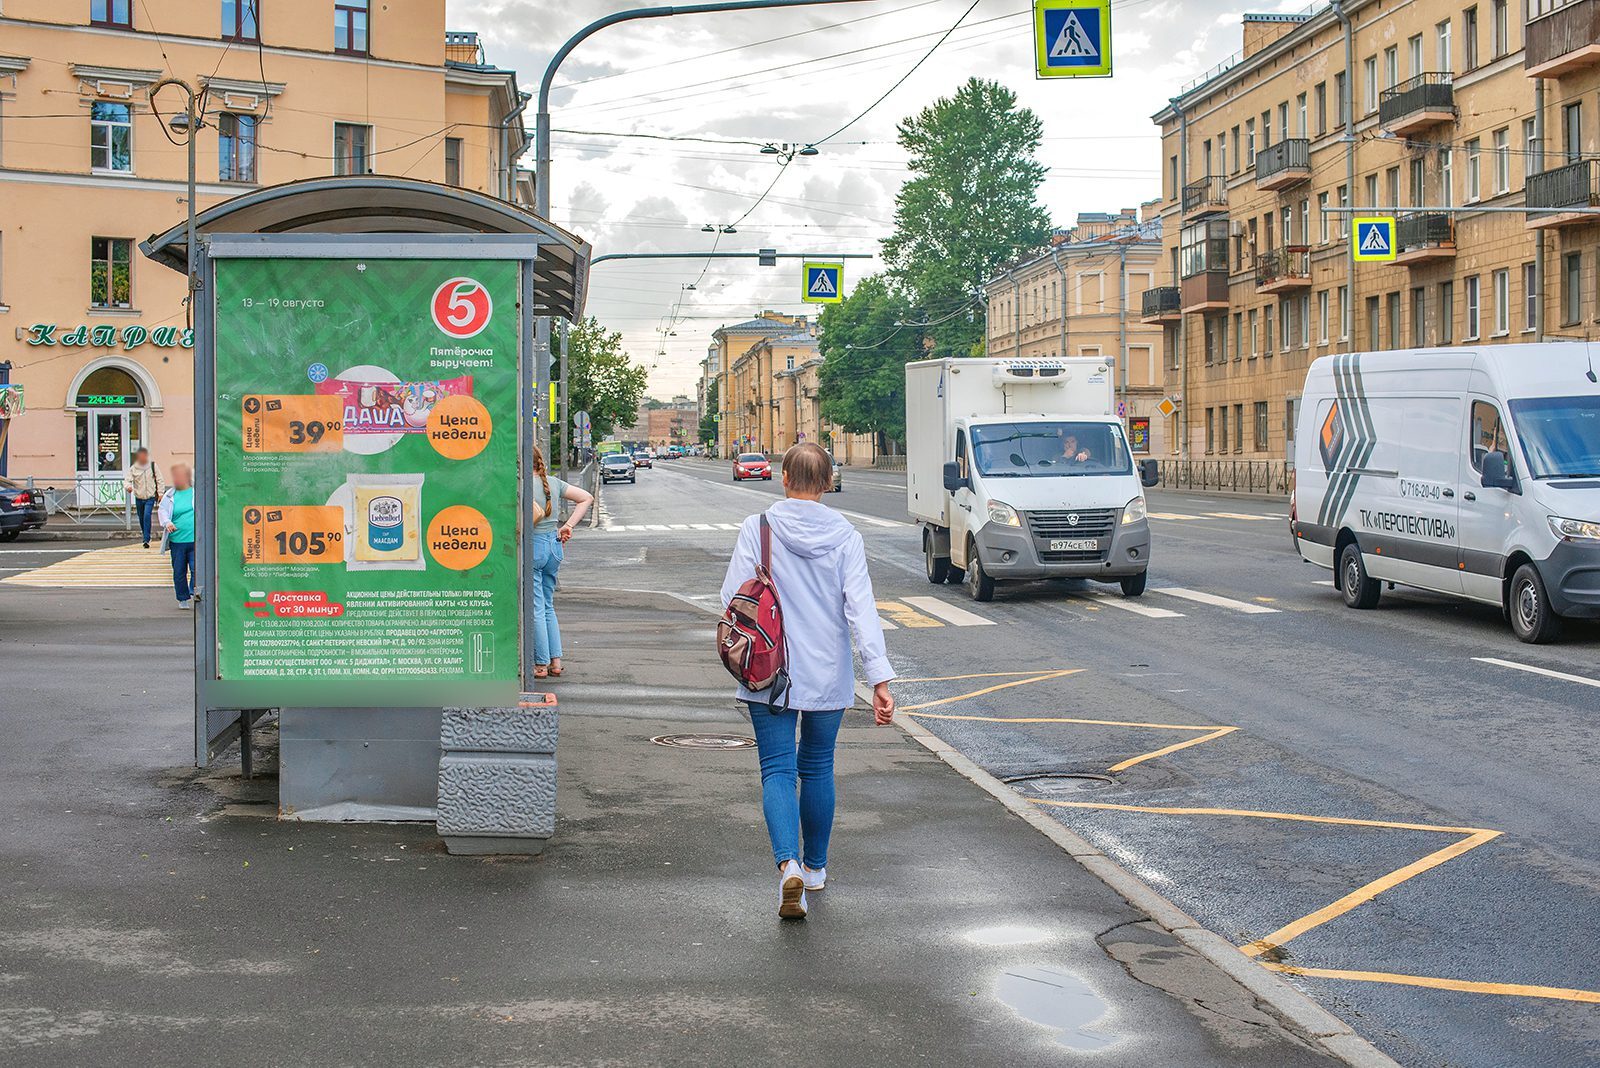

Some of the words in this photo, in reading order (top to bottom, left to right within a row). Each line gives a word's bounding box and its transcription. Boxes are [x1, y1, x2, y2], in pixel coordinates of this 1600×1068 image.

[242, 298, 253, 308] 13
[268, 298, 279, 308] 19
[282, 299, 325, 310] августа
[430, 347, 493, 358] Пятёрочка
[430, 360, 493, 370] выручает!
[343, 406, 405, 427] ДАША
[440, 415, 479, 427] Цена
[289, 421, 325, 445] 39
[432, 429, 486, 440] недели
[1407, 482, 1440, 500] 716-20-40
[1360, 509, 1373, 528] ТК
[1374, 512, 1455, 539] «ПЕРСПЕКТИВА»
[440, 526, 479, 537] Цена
[275, 531, 326, 555] 105
[432, 539, 487, 550] недели
[273, 593, 321, 603] Доставка
[346, 591, 379, 599] АКЦИОННЫЕ
[380, 591, 396, 599] ЦЕНЫ
[396, 591, 441, 599] ДЕЙСТВИТЕЛЬНЫ
[441, 591, 462, 599] ТОЛЬКО
[463, 591, 473, 599] ПРИ
[280, 606, 292, 614] от
[293, 606, 305, 614] 30
[307, 606, 339, 616] минут
[332, 620, 364, 628] КОЛИЧЕСТВО
[365, 620, 385, 628] ТОВАРА
[244, 629, 276, 637] МАГАЗИНАХ
[276, 629, 303, 637] ТОРГОВОЙ
[319, 629, 334, 637] ЦЕНЫ
[335, 629, 359, 637] УКАЗАНЫ
[386, 629, 416, 637] ПРОДАВЕЦ
[244, 639, 259, 647] ОГРН
[356, 639, 382, 647] НЕВСКИЙ
[244, 649, 270, 657] ДОСТАВКИ
[307, 649, 345, 657] ПОДРОБНОСТИ
[355, 649, 389, 657] МОБИЛЬНОМ
[390, 649, 426, 657] ПРИЛОЖЕНИИ
[473, 634, 492, 673] 18+
[244, 659, 273, 667] ДОСТАВКУ
[274, 659, 319, 667] ОСУЩЕСТВЛЯЕТ
[334, 659, 348, 667] «ИКС
[244, 668, 278, 676] НИКОВСКАЯ,
[381, 668, 395, 676] ОГРН
